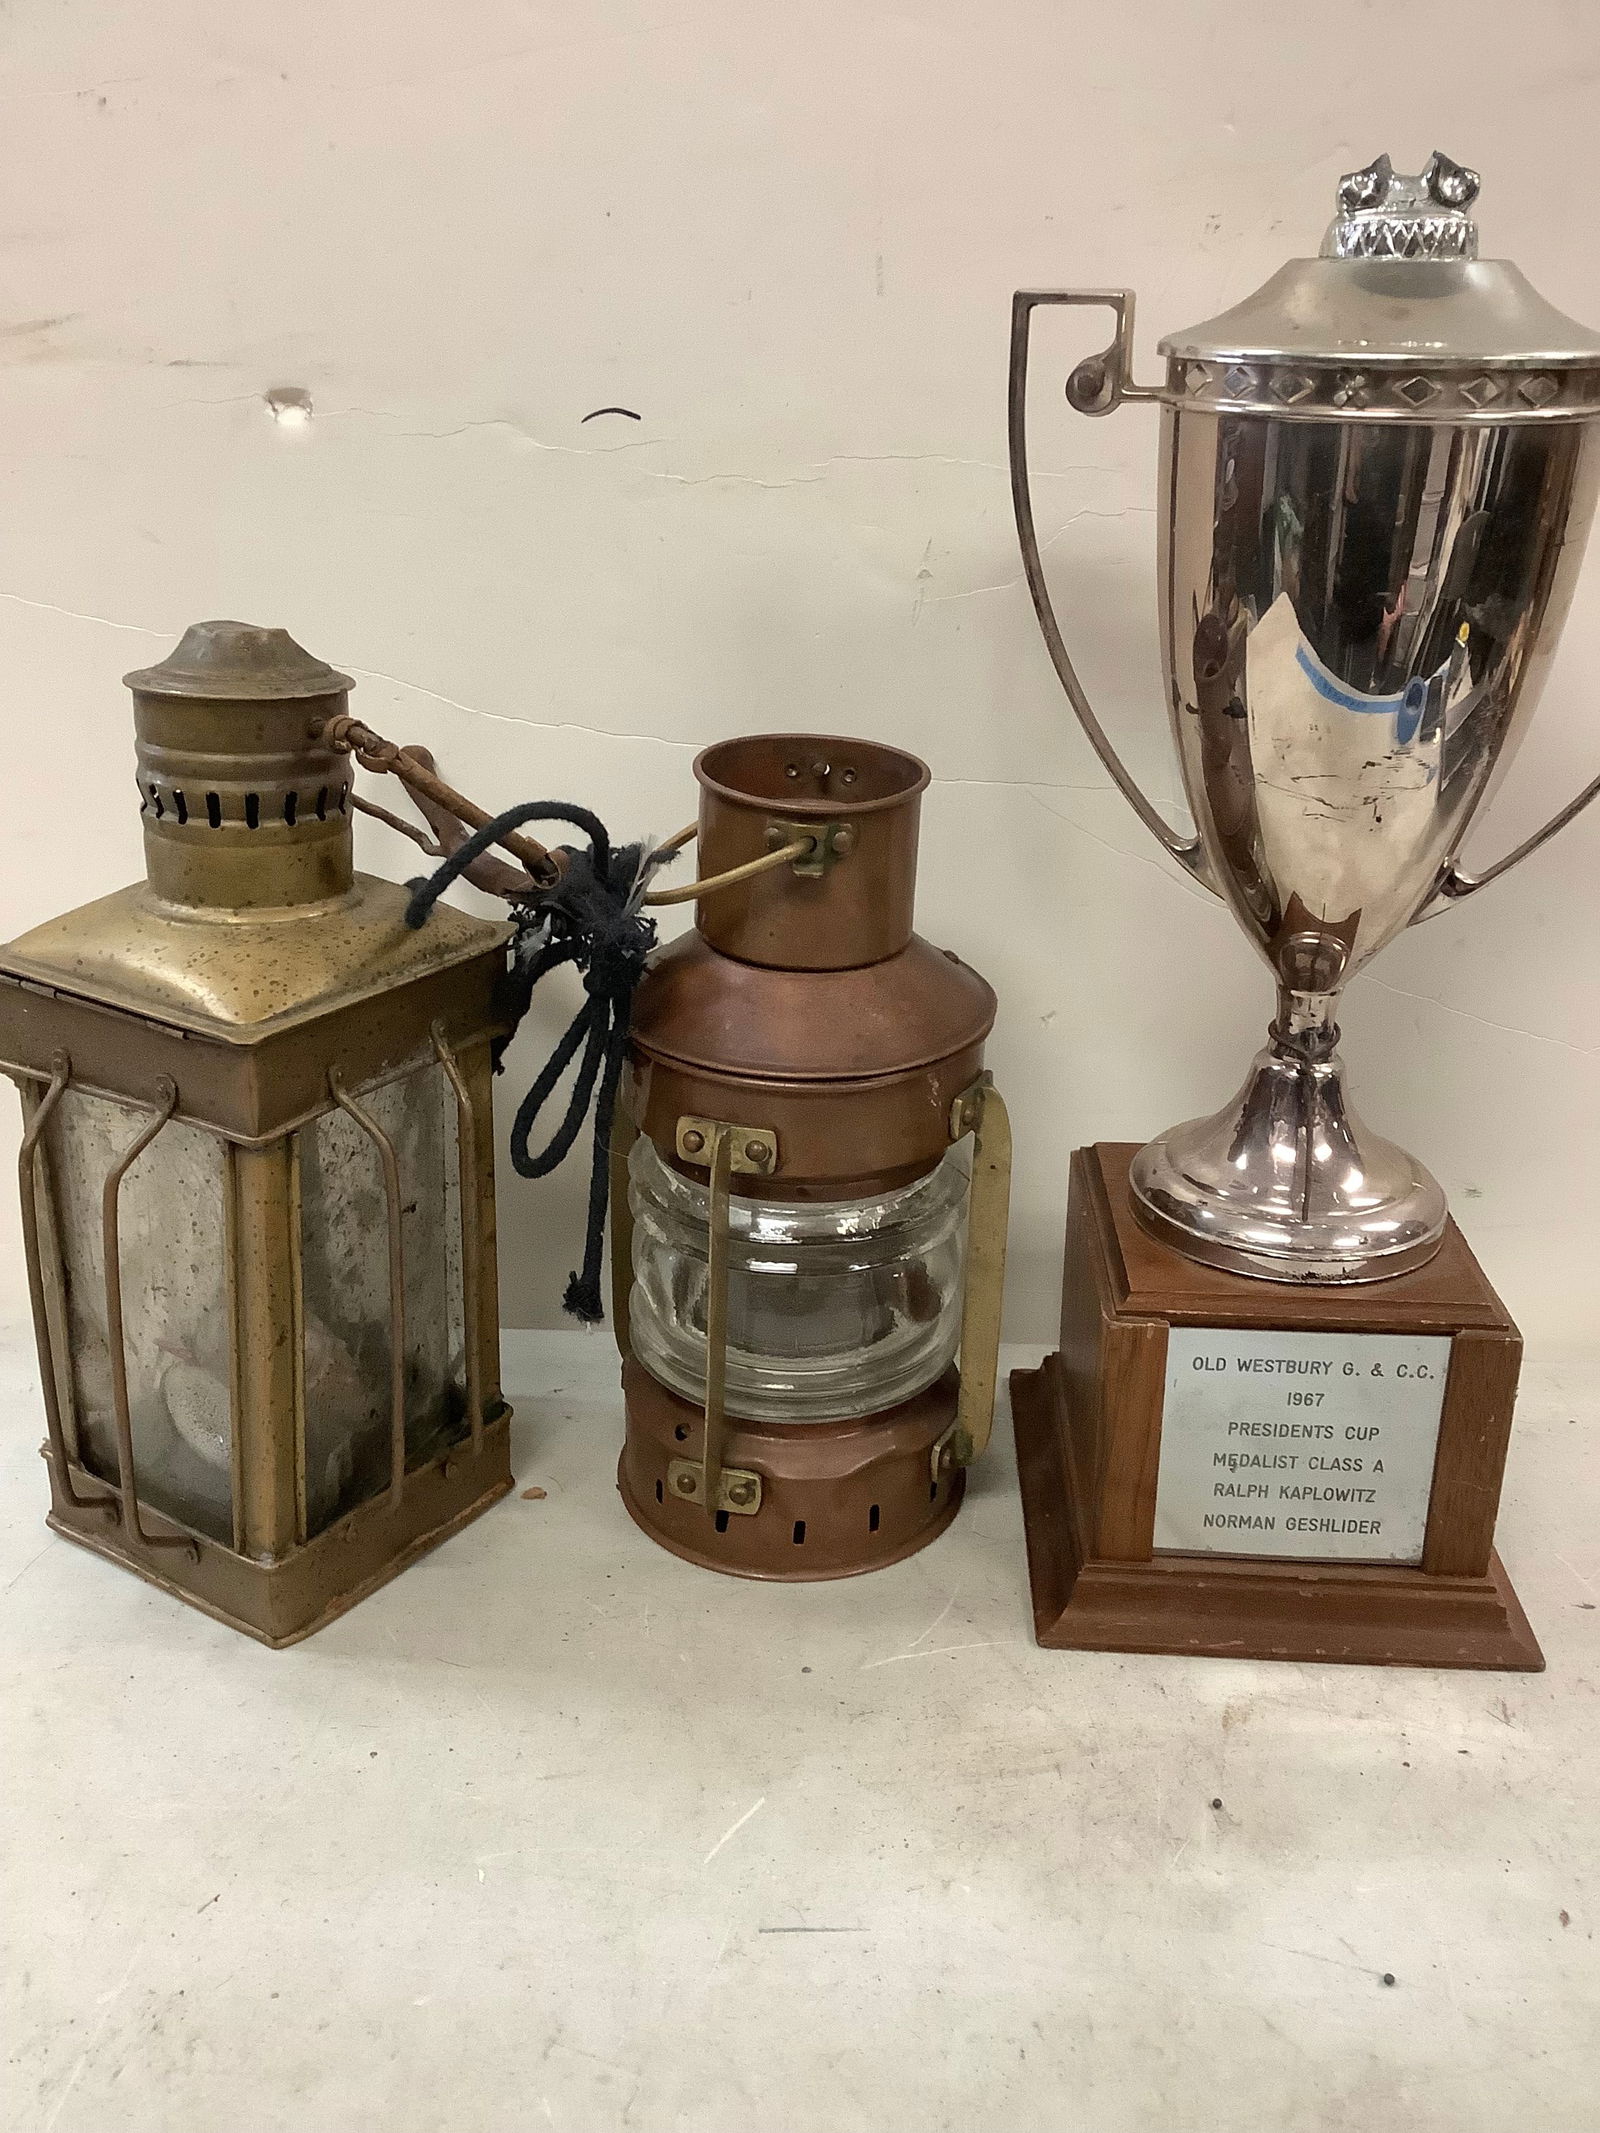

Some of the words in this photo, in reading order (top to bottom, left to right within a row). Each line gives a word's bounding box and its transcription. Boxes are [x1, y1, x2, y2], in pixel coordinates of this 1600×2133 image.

[1192, 1356, 1227, 1371] OLD
[1236, 1357, 1334, 1376] WESTBURY
[1342, 1361, 1361, 1377] G.
[1370, 1362, 1385, 1378] &
[1396, 1363, 1435, 1380] C.C.
[1286, 1391, 1325, 1407] 1967
[1227, 1421, 1334, 1440] PRESIDENTS
[1344, 1425, 1380, 1441] CUP
[1213, 1452, 1300, 1470] MEDALIST
[1308, 1456, 1363, 1472] CLASS
[1372, 1458, 1384, 1473] A
[1213, 1482, 1269, 1499] RALPH
[1278, 1485, 1377, 1503] KAPLOWITZ
[1203, 1513, 1276, 1531] NORMAN
[1285, 1516, 1382, 1535] GESHLIDER
